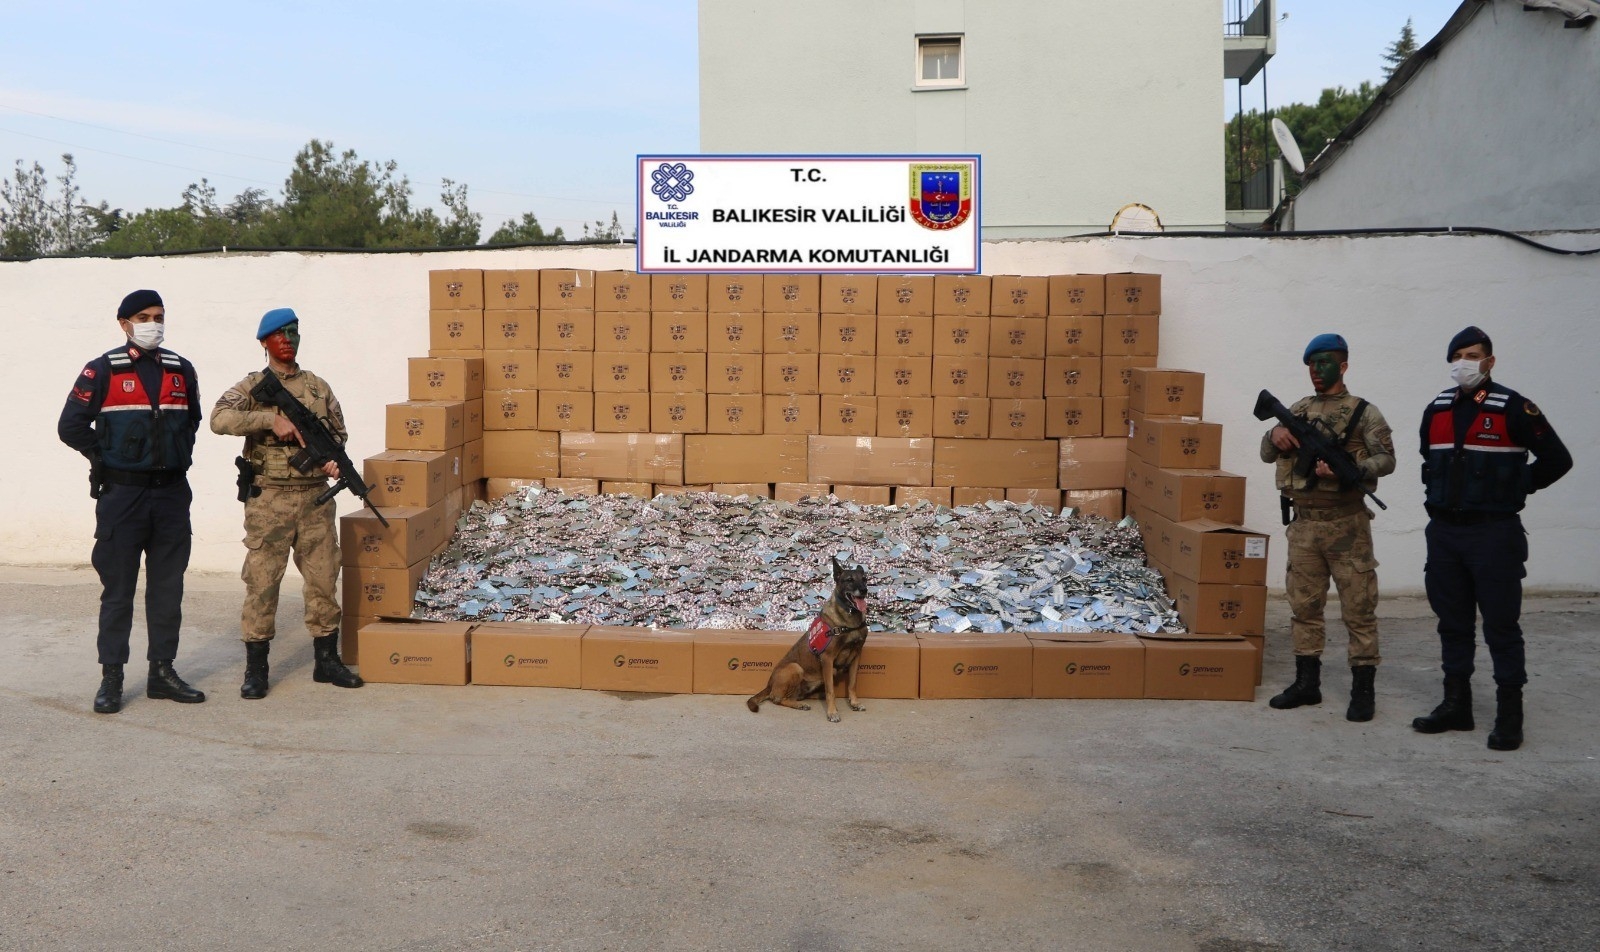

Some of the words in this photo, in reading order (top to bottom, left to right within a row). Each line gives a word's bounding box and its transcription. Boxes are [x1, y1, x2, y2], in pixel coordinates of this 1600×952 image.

[403, 655, 433, 663] genveon
[518, 657, 548, 665] genveon
[628, 658, 659, 666] genveon
[742, 660, 773, 668] genveon
[967, 664, 998, 672] genveon
[1080, 664, 1111, 672] genveon
[1193, 666, 1224, 674] genveon
